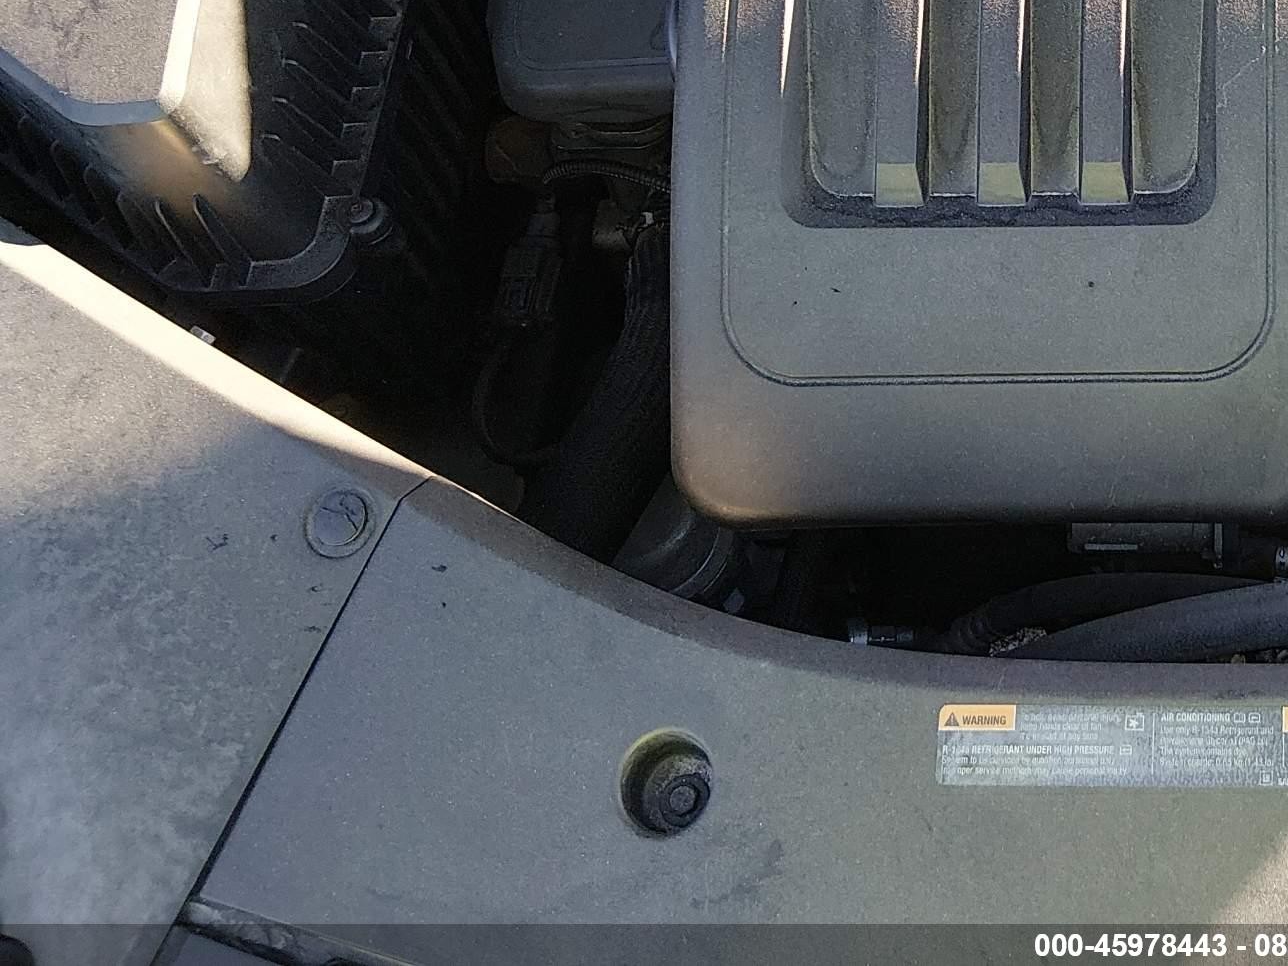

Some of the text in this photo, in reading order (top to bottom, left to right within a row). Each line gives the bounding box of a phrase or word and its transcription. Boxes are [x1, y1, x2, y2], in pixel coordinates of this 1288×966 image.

[962, 715, 1007, 726] WARNING
[1160, 712, 1231, 723] AIR CONDITIONING
[1026, 745, 1052, 755] UNDER
[1074, 745, 1115, 755] PRESSURE
